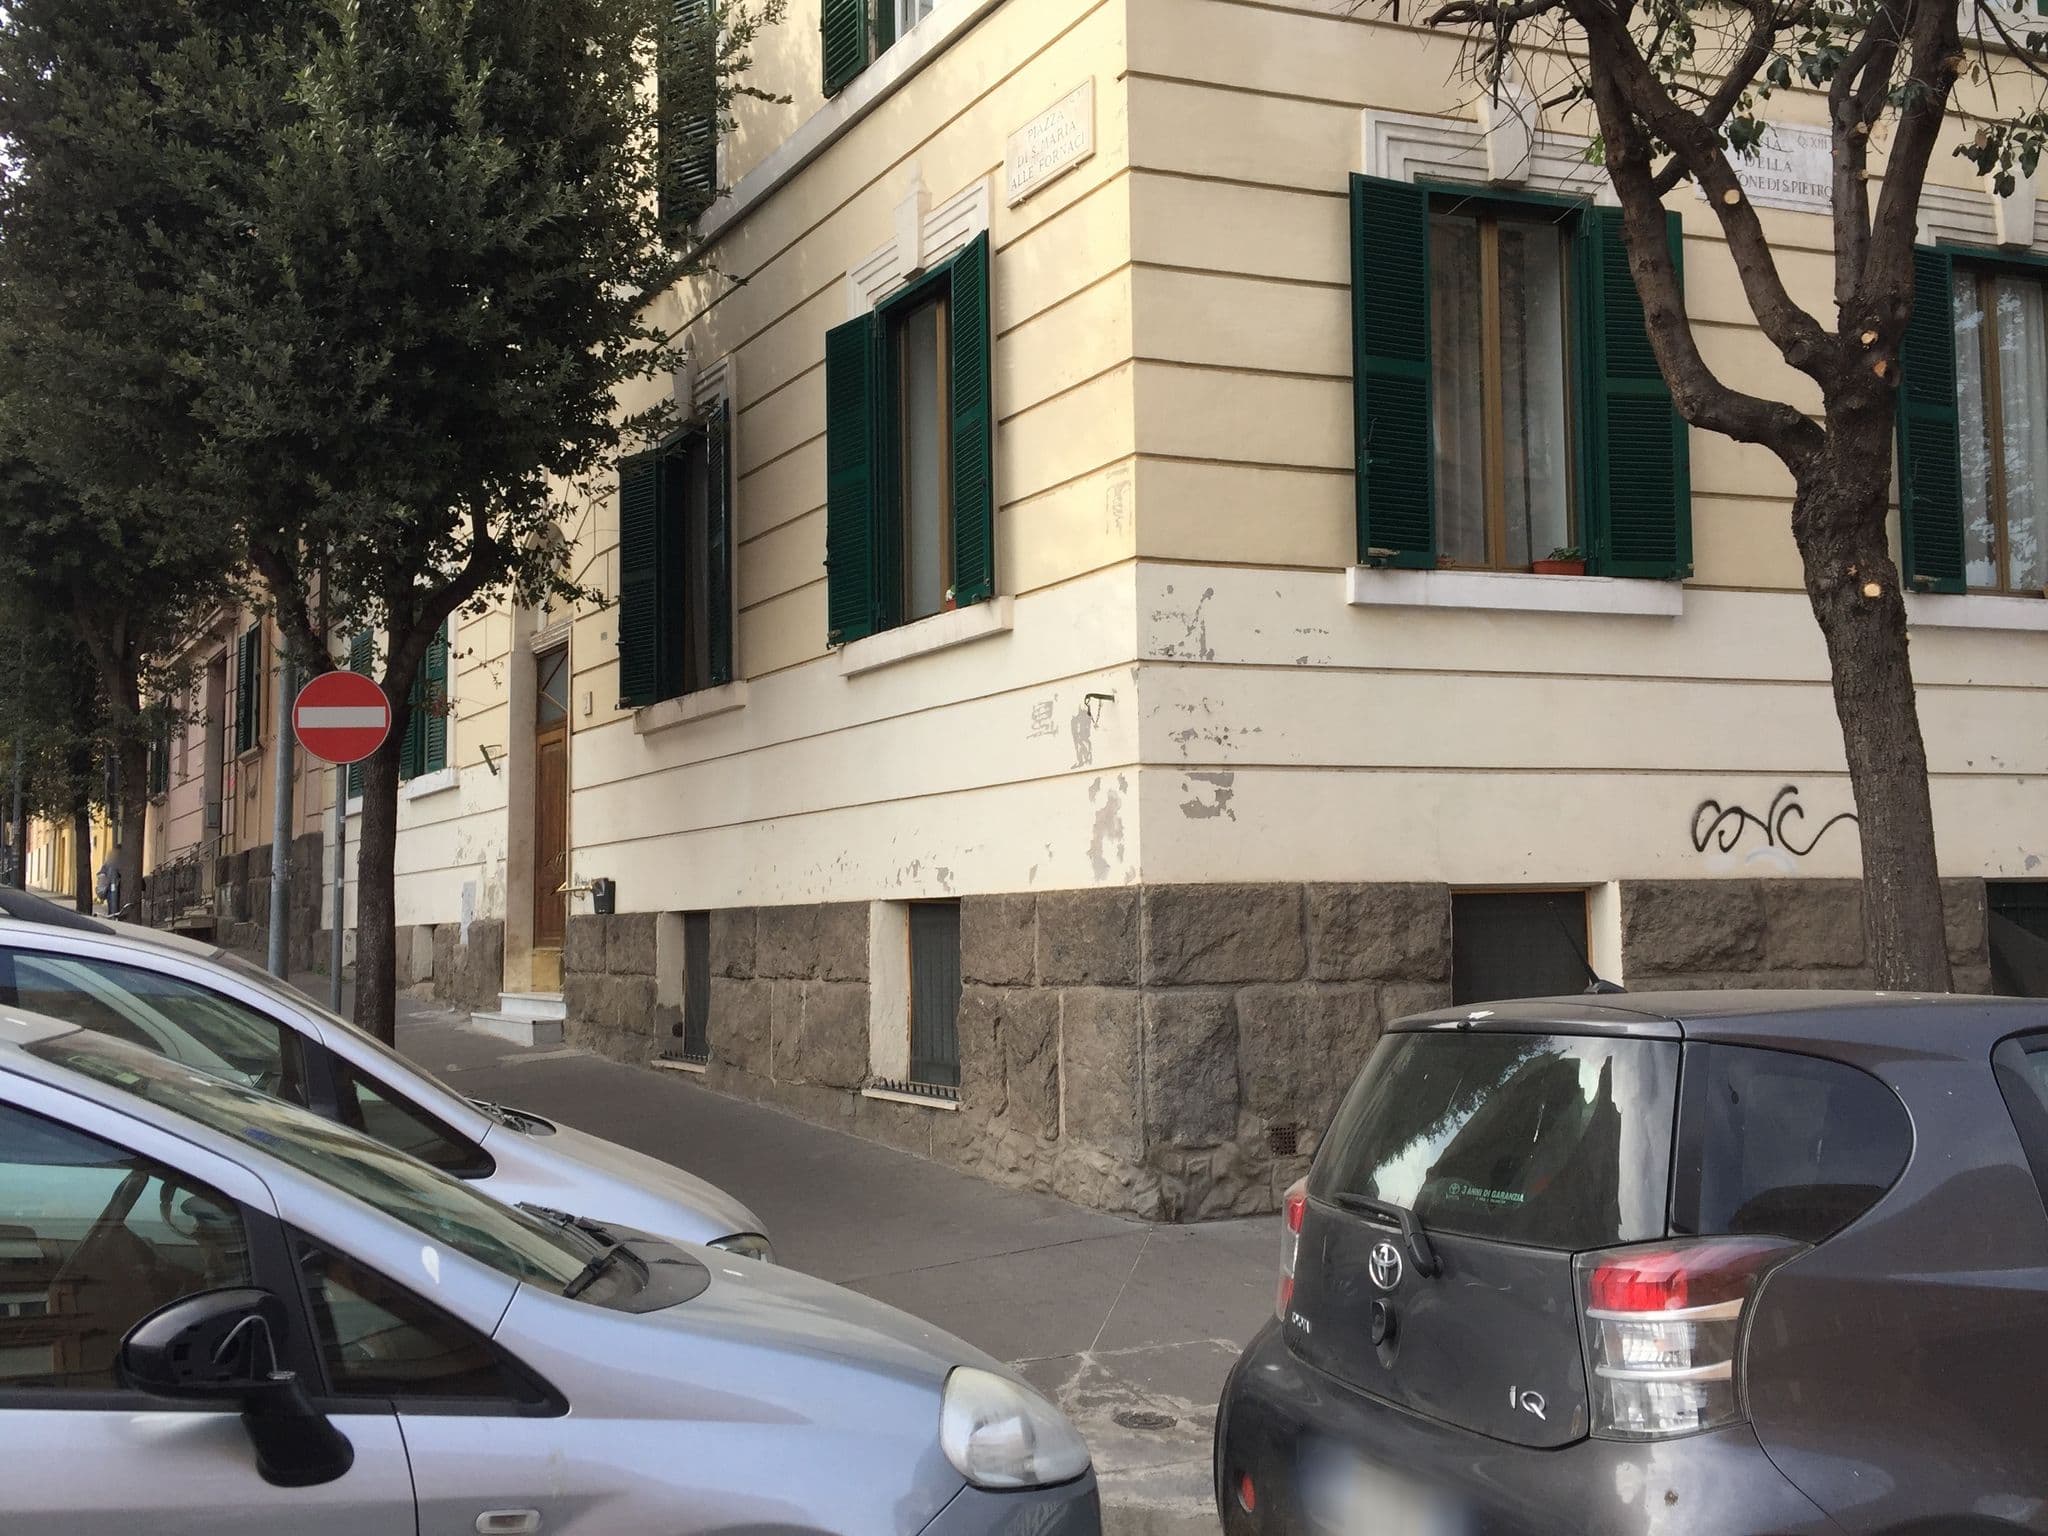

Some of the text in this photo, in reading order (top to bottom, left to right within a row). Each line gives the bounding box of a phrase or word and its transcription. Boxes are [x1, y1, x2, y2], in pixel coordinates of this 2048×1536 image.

[1028, 111, 1064, 138] PIAZZA
[1017, 152, 1028, 168] DI
[1745, 157, 1792, 173] DELLA
[1011, 166, 1033, 190] ALLE
[1767, 177, 1780, 192] DI
[1491, 1190, 1524, 1202] GARANZIA
